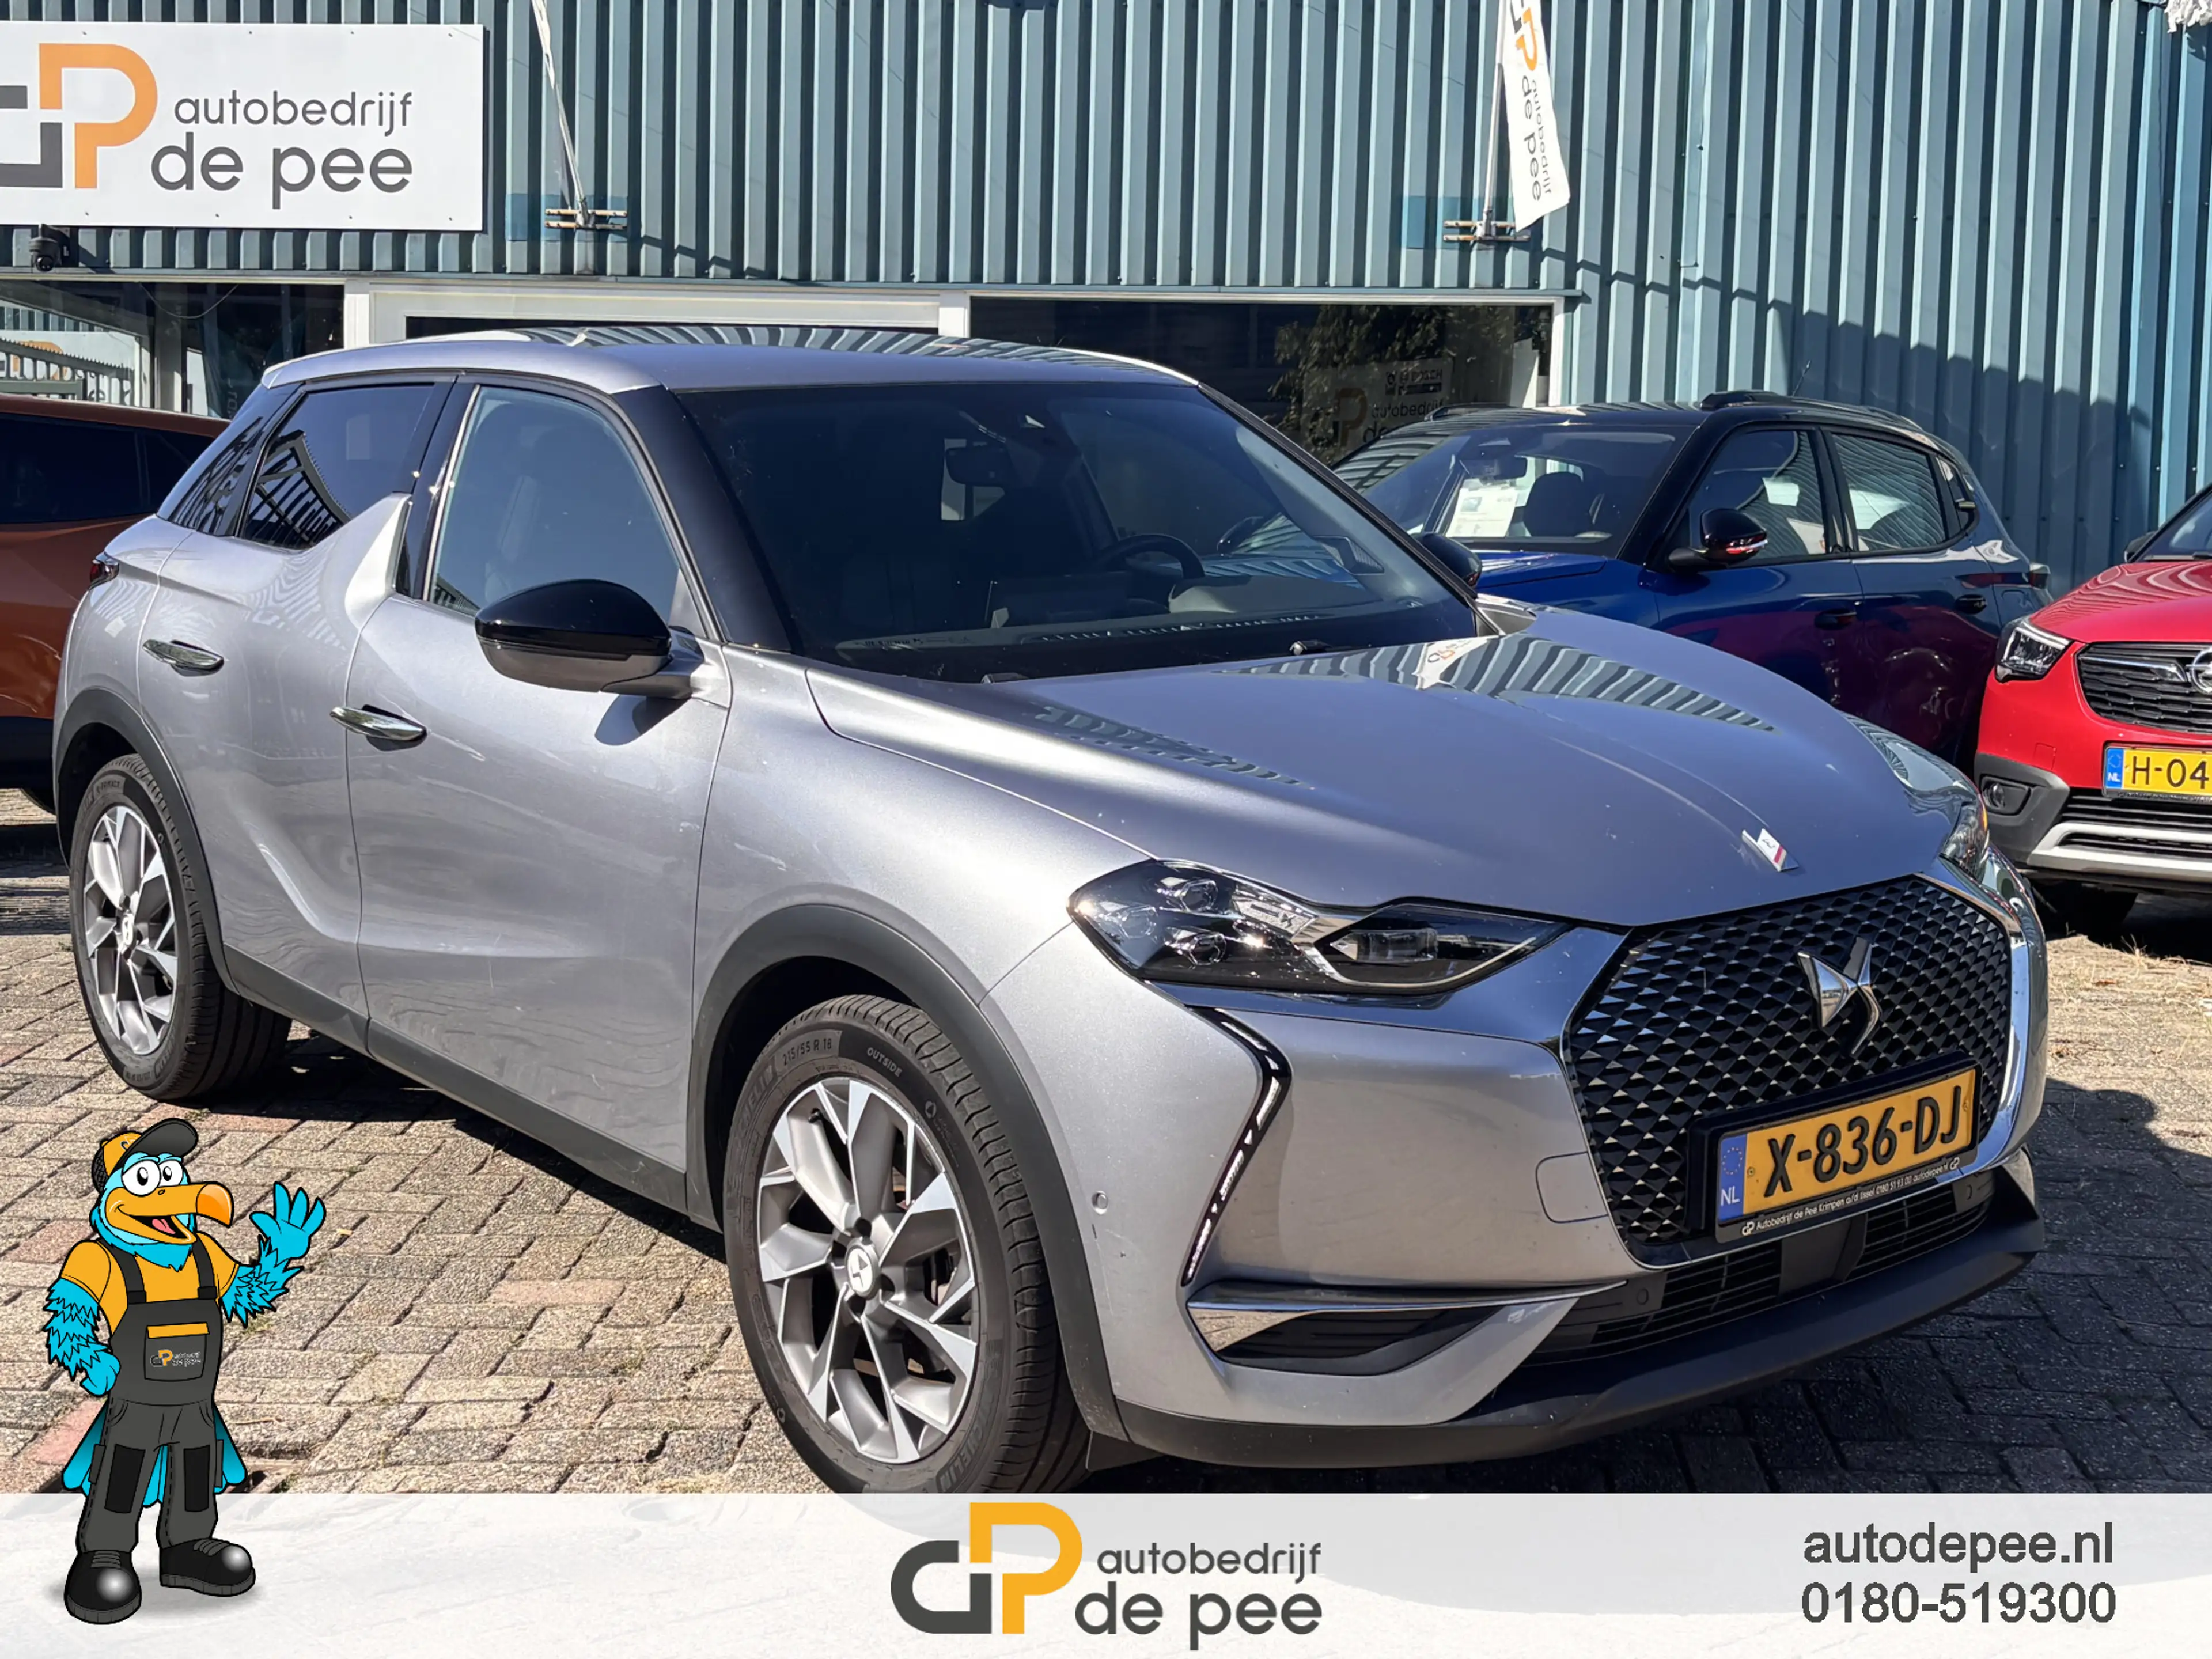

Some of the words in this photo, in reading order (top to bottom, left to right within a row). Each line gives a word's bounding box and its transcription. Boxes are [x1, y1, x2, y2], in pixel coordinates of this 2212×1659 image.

[174, 90, 412, 137] autobedrijf
[1522, 75, 1532, 120] de
[151, 131, 243, 191] de
[272, 146, 412, 210] pee
[1524, 132, 1541, 201] pee
[2108, 772, 2120, 782] NL
[2131, 756, 2209, 790] H-04
[866, 1047, 903, 1077] OUTSIDE
[1763, 1085, 1962, 1198] X-836-DJ
[1721, 1185, 1740, 1206] NL
[1756, 1211, 1793, 1230] Autobedrijf
[1794, 1210, 1803, 1219] de
[1805, 1206, 1817, 1216] Pee
[1819, 1198, 1845, 1212] Krimpen
